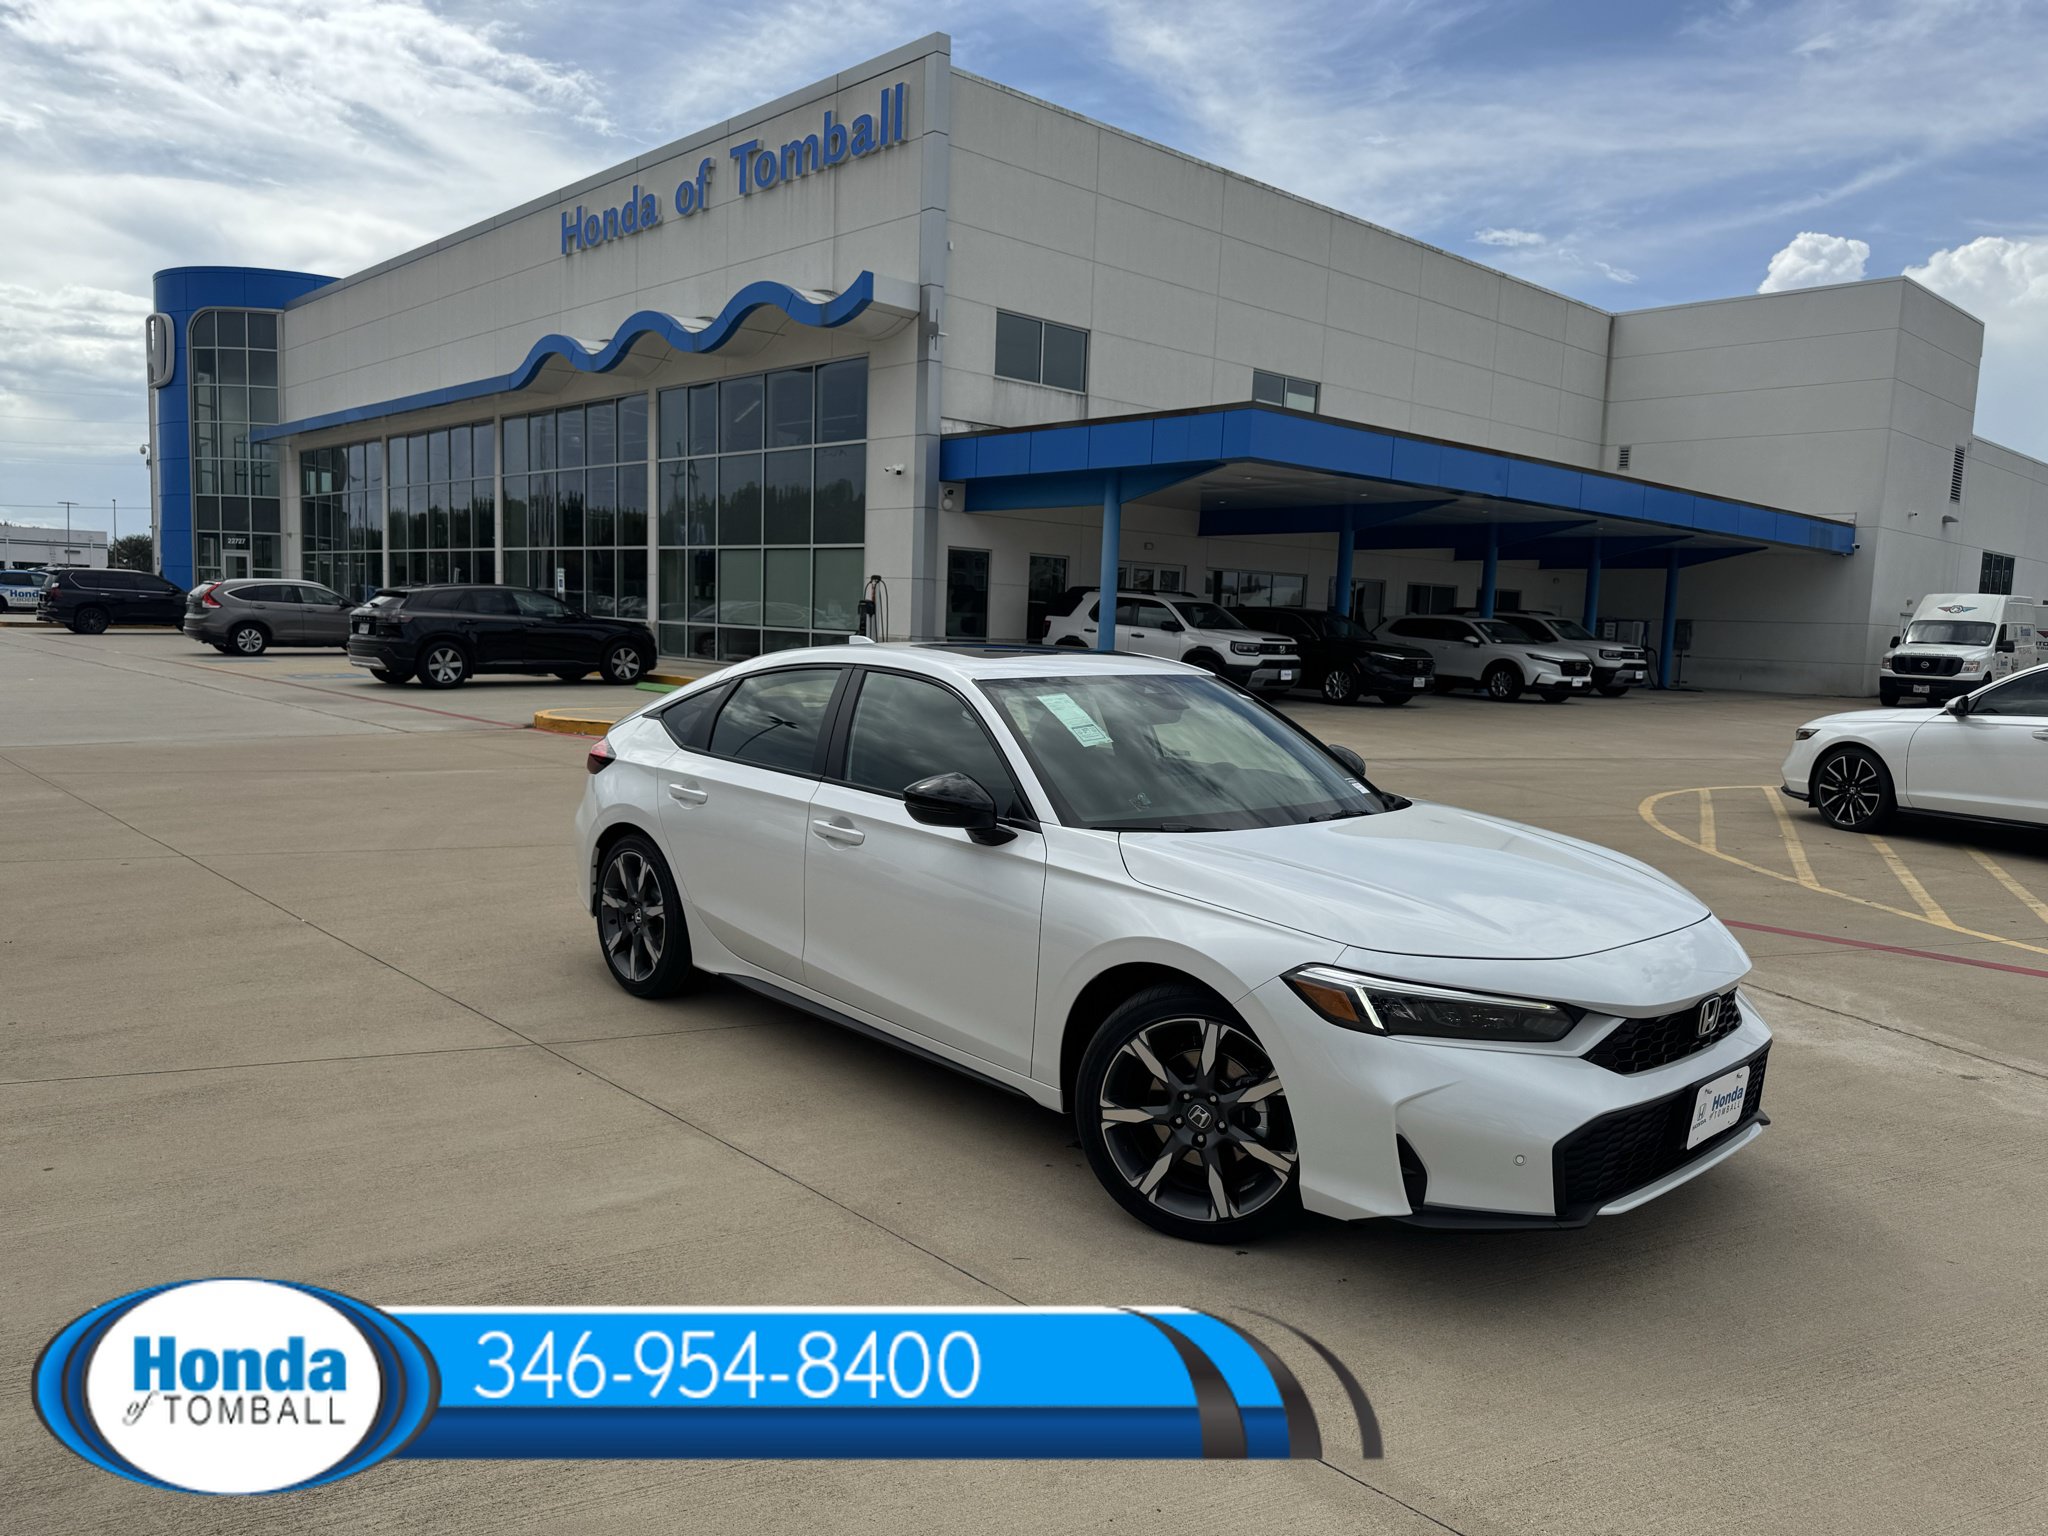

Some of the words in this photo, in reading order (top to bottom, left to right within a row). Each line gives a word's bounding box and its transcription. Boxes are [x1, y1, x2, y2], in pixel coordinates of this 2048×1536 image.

[561, 184, 660, 255] Honda
[675, 157, 714, 216] of
[730, 82, 908, 196] Tomball
[10, 590, 40, 598] Hond
[1711, 1085, 1744, 1112] Honda
[1714, 1101, 1741, 1119] TOMBALL
